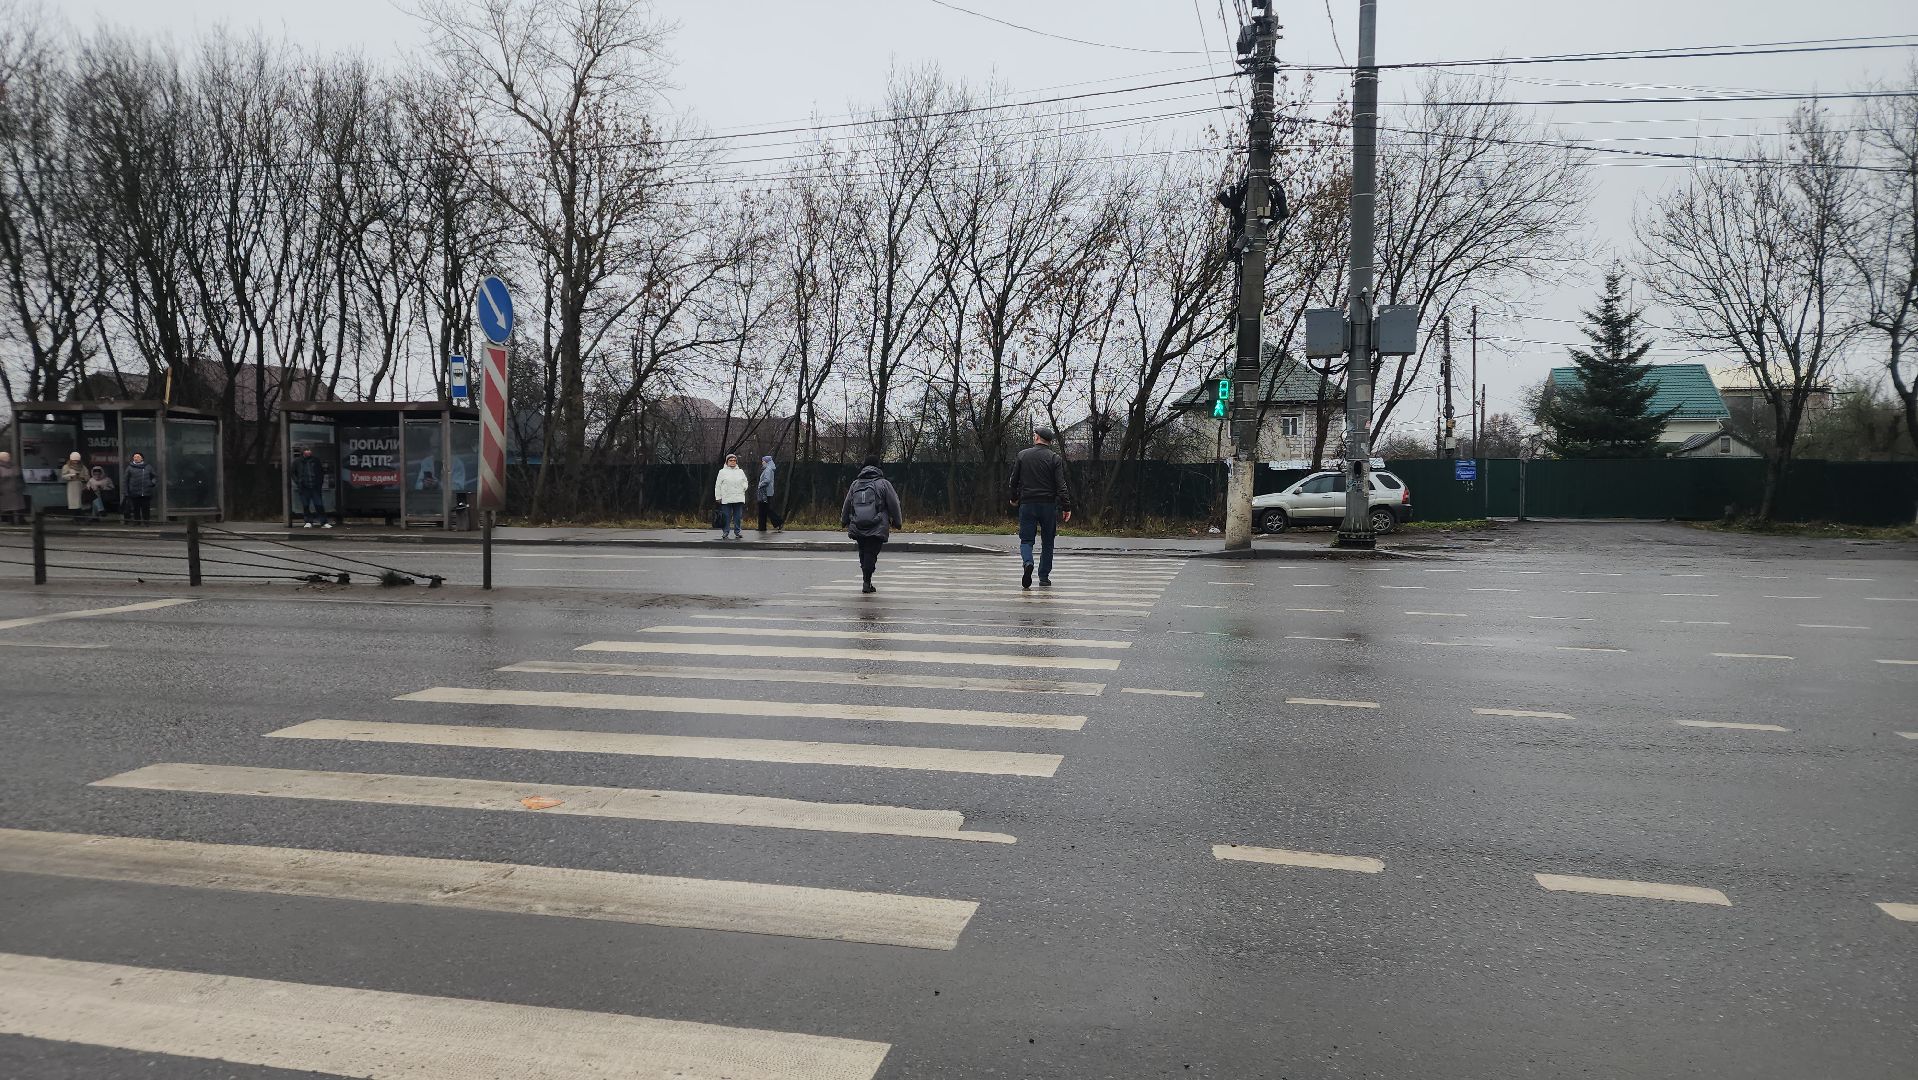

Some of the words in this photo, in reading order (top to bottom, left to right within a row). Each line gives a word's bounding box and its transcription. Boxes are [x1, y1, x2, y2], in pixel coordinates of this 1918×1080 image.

[350, 440, 400, 450] ПОПАЛИ
[350, 455, 358, 466] В
[361, 455, 393, 468] ДТП?
